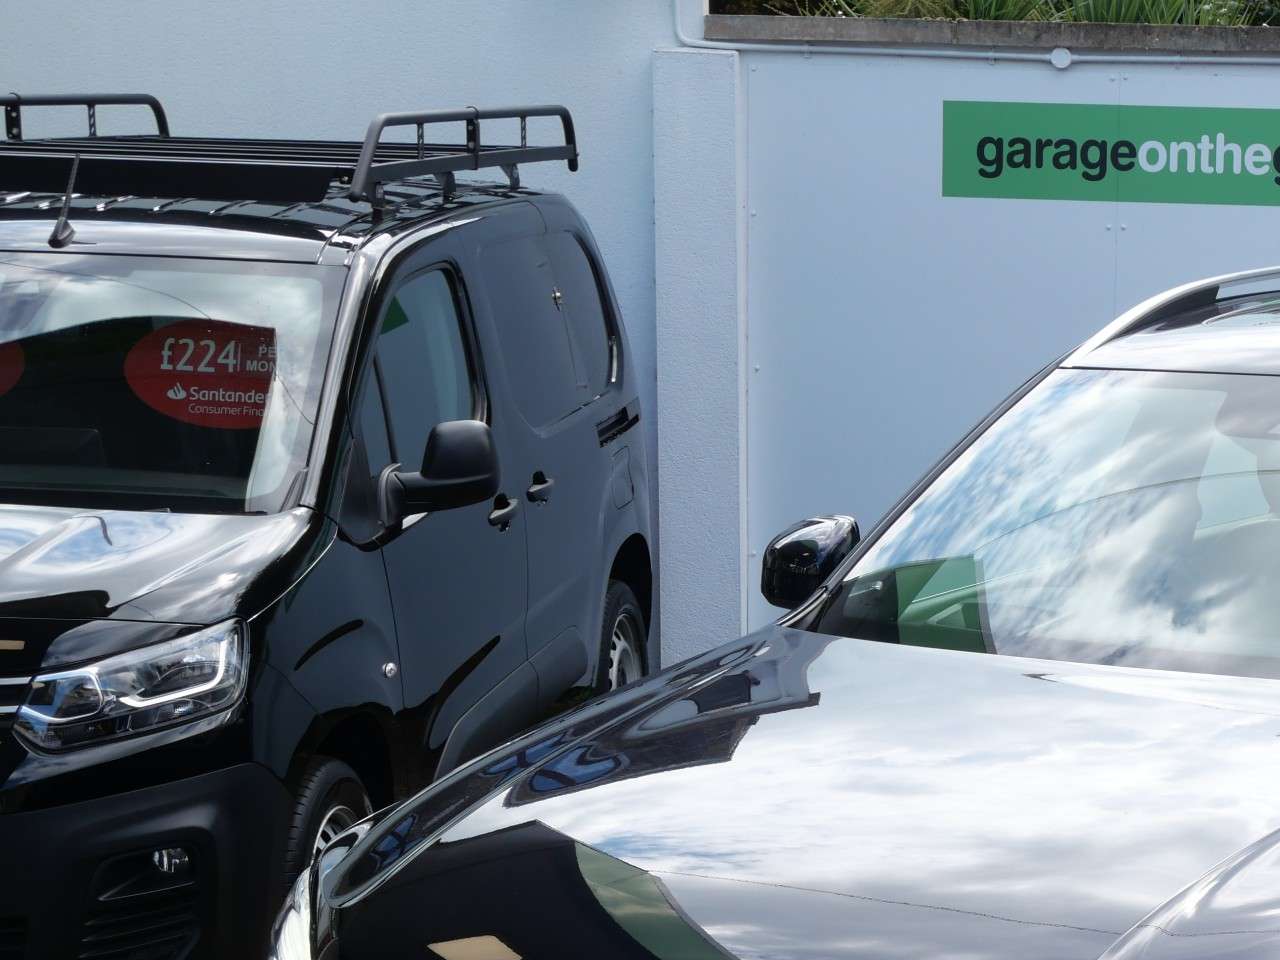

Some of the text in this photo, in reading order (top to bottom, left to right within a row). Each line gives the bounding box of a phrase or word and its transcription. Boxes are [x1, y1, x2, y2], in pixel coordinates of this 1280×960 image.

[160, 337, 237, 373] £224
[258, 344, 277, 358] PE
[246, 360, 277, 372] MON
[189, 386, 268, 404] Santande
[188, 402, 242, 415] Consumer
